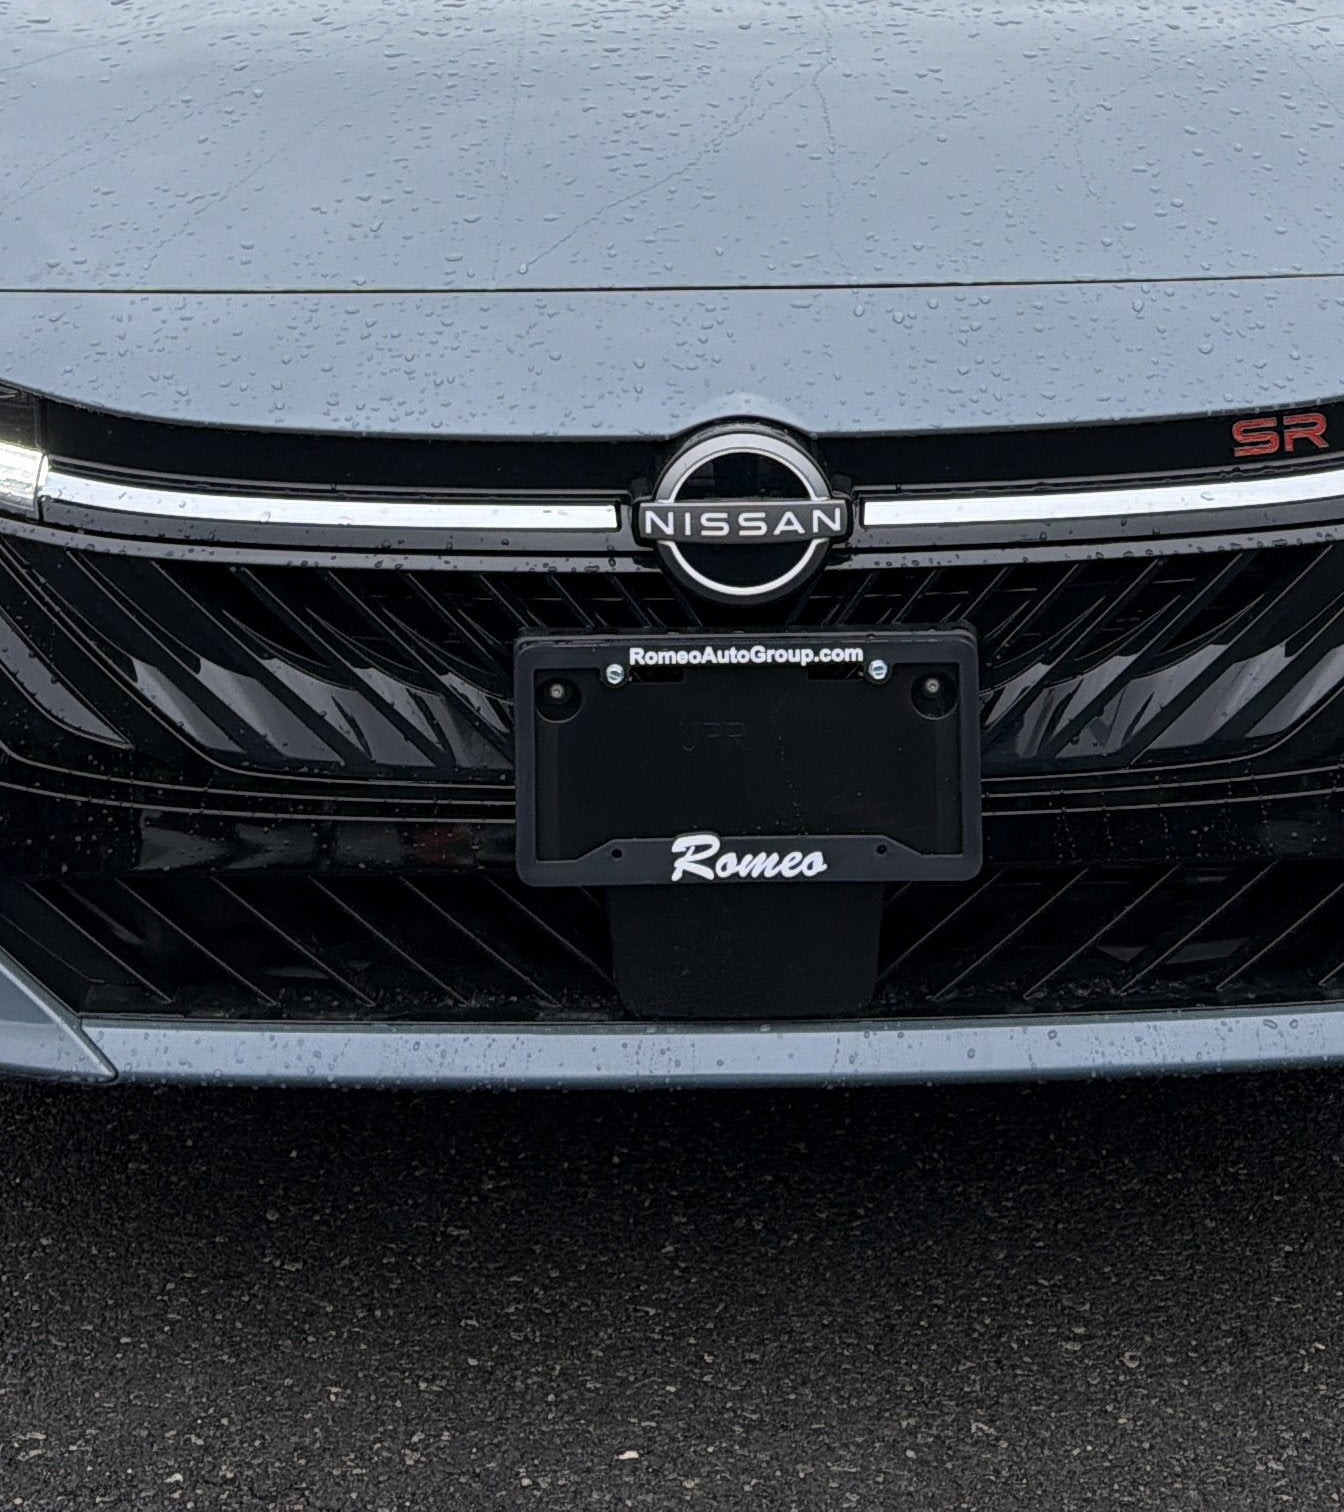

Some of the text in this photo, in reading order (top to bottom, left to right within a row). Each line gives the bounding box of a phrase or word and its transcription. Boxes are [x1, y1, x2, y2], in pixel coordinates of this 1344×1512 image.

[1232, 414, 1327, 457] SR
[644, 507, 842, 536] NISSAN
[629, 645, 864, 666] RomeoAutoGroup.com
[671, 834, 828, 881] Romeo
